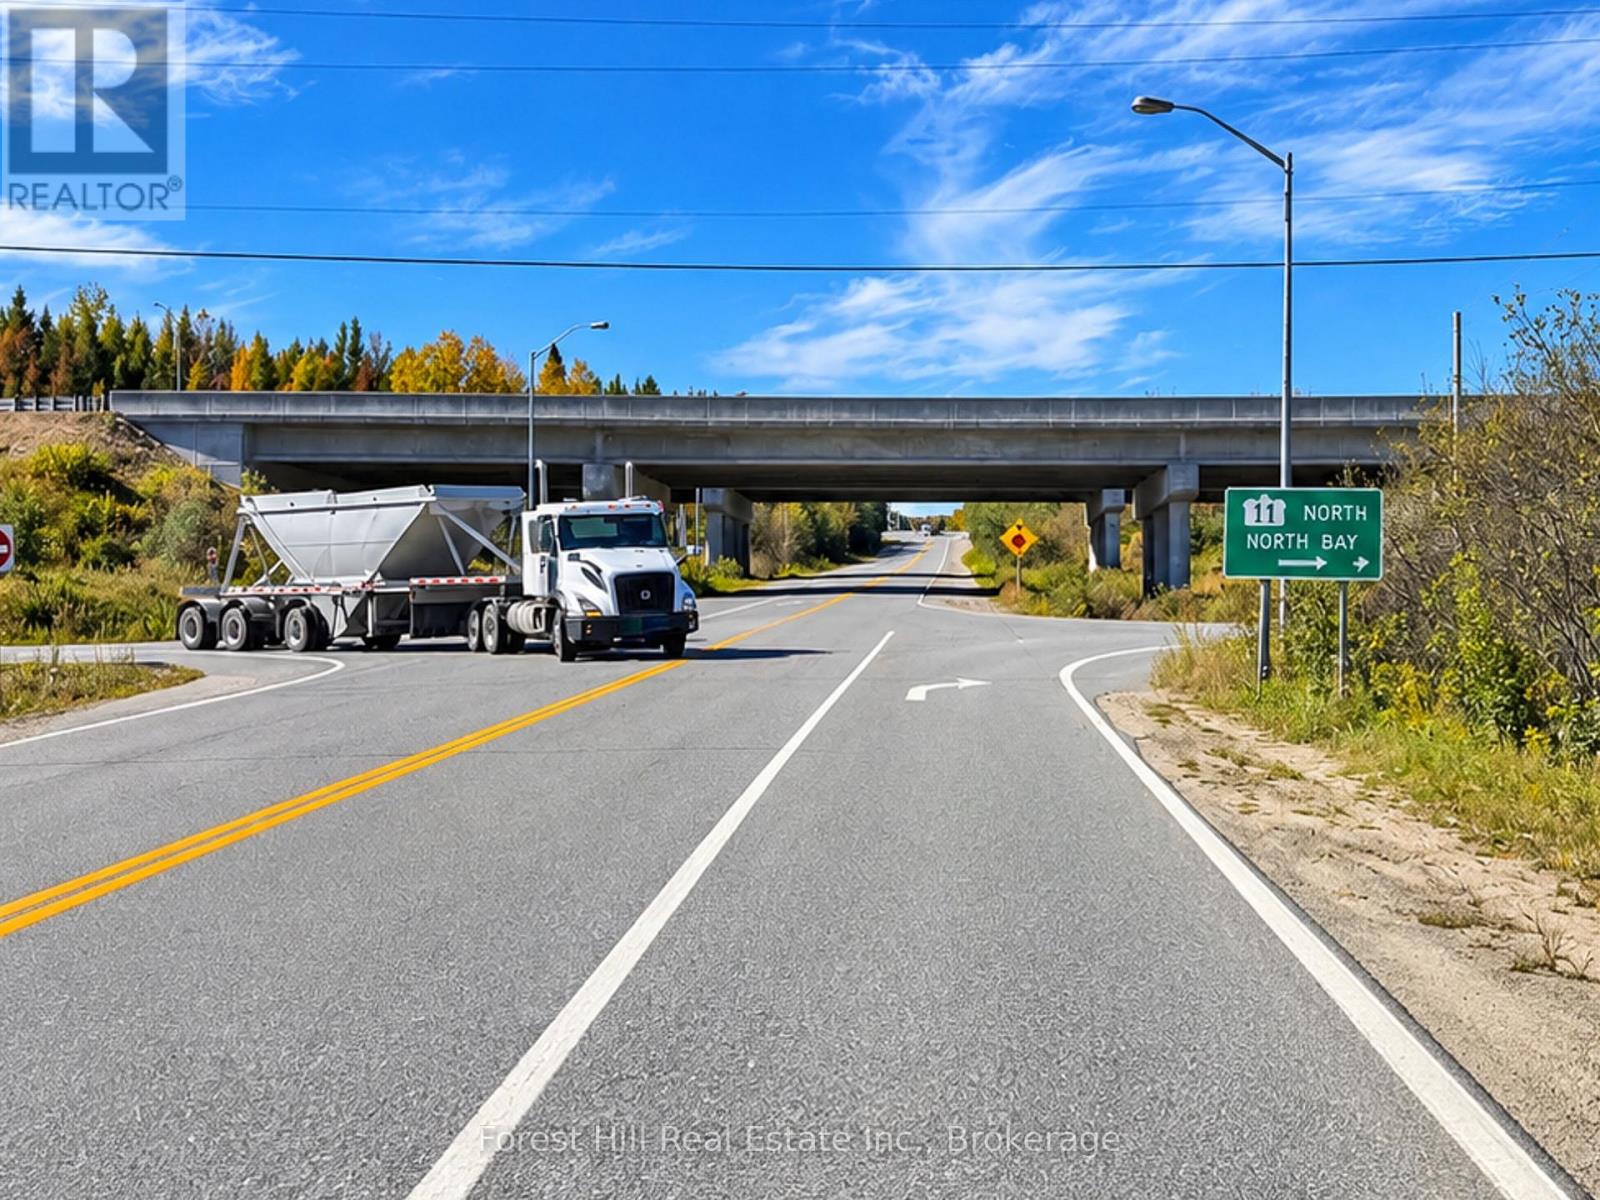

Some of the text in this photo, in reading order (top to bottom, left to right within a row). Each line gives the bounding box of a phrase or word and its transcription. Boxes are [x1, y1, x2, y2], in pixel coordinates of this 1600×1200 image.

[1253, 502, 1368, 524] 11 NORTH
[1246, 533, 1359, 551] NORTH BAY
